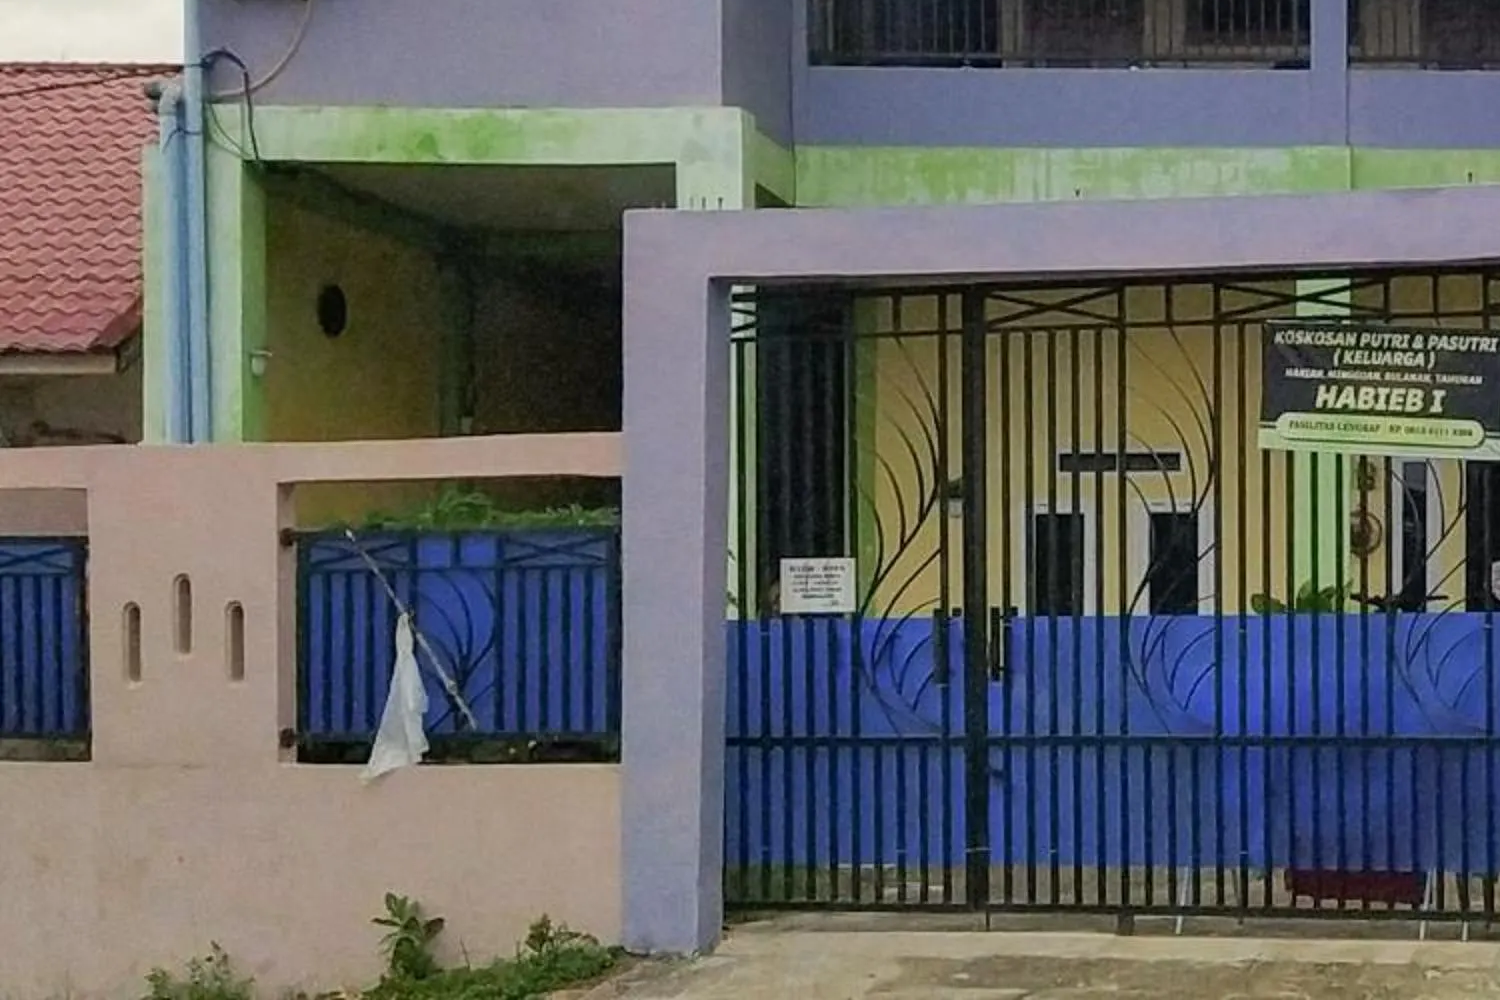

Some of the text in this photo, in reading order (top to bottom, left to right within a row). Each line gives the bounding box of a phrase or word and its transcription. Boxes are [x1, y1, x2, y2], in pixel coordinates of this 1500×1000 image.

[1274, 330, 1499, 353] KOSKOSAN PUTRI & PASUTRI
[1315, 385, 1448, 413] HABIEB I
